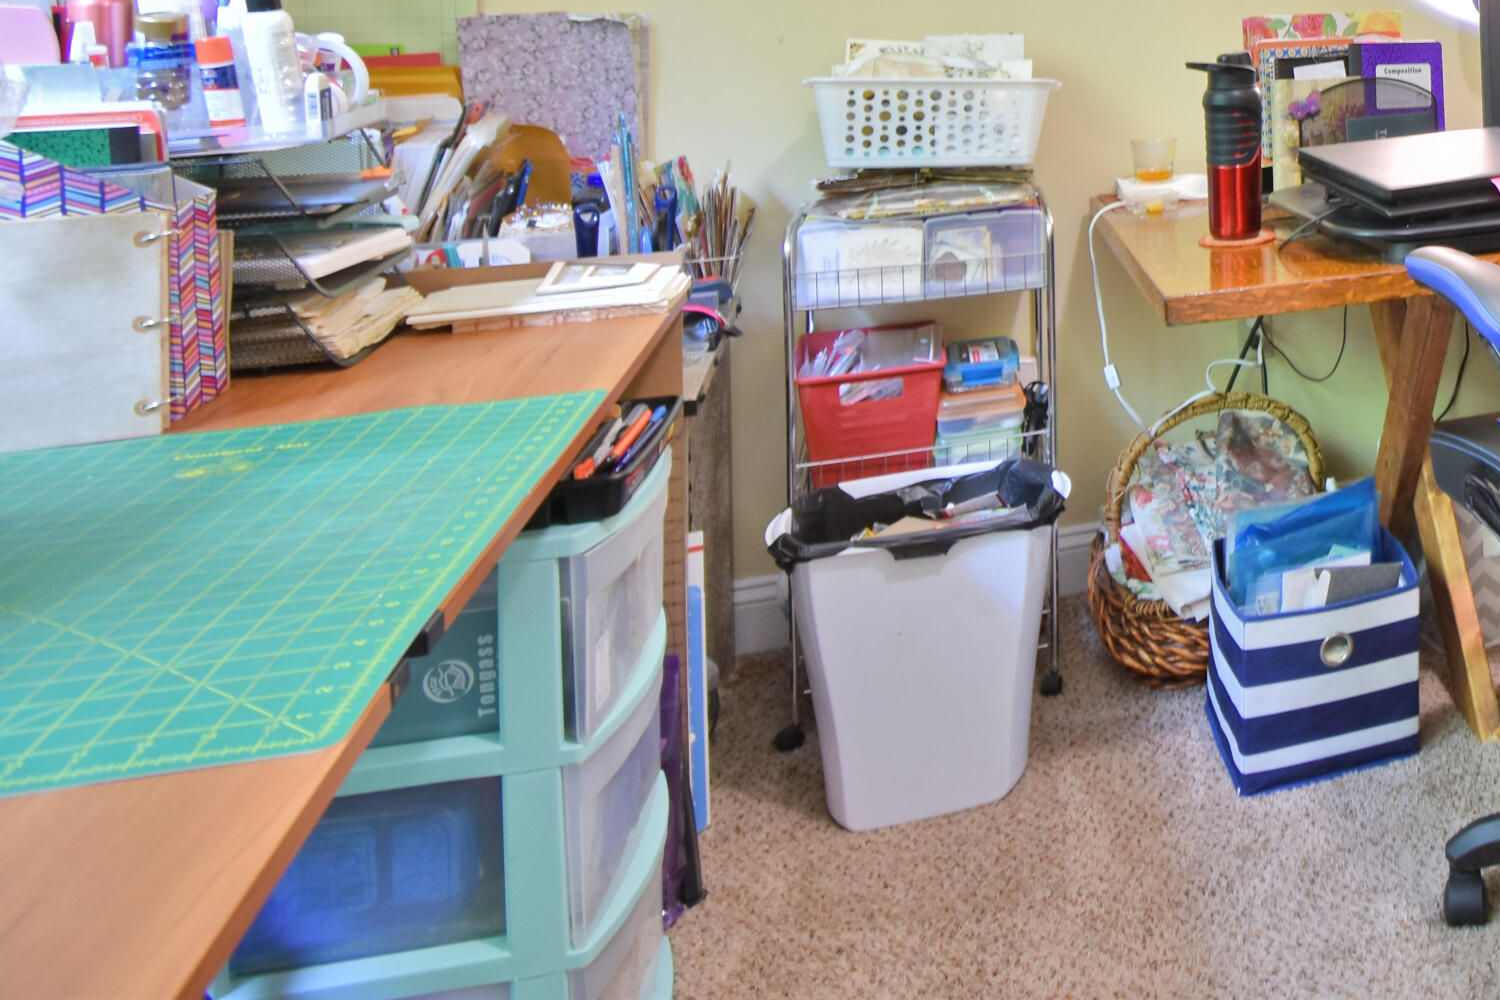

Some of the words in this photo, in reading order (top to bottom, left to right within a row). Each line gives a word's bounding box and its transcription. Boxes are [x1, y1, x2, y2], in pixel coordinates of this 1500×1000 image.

[1384, 66, 1422, 75] Composition
[334, 661, 351, 670] 3
[478, 634, 497, 718] Tongass
[315, 685, 333, 694] 2
